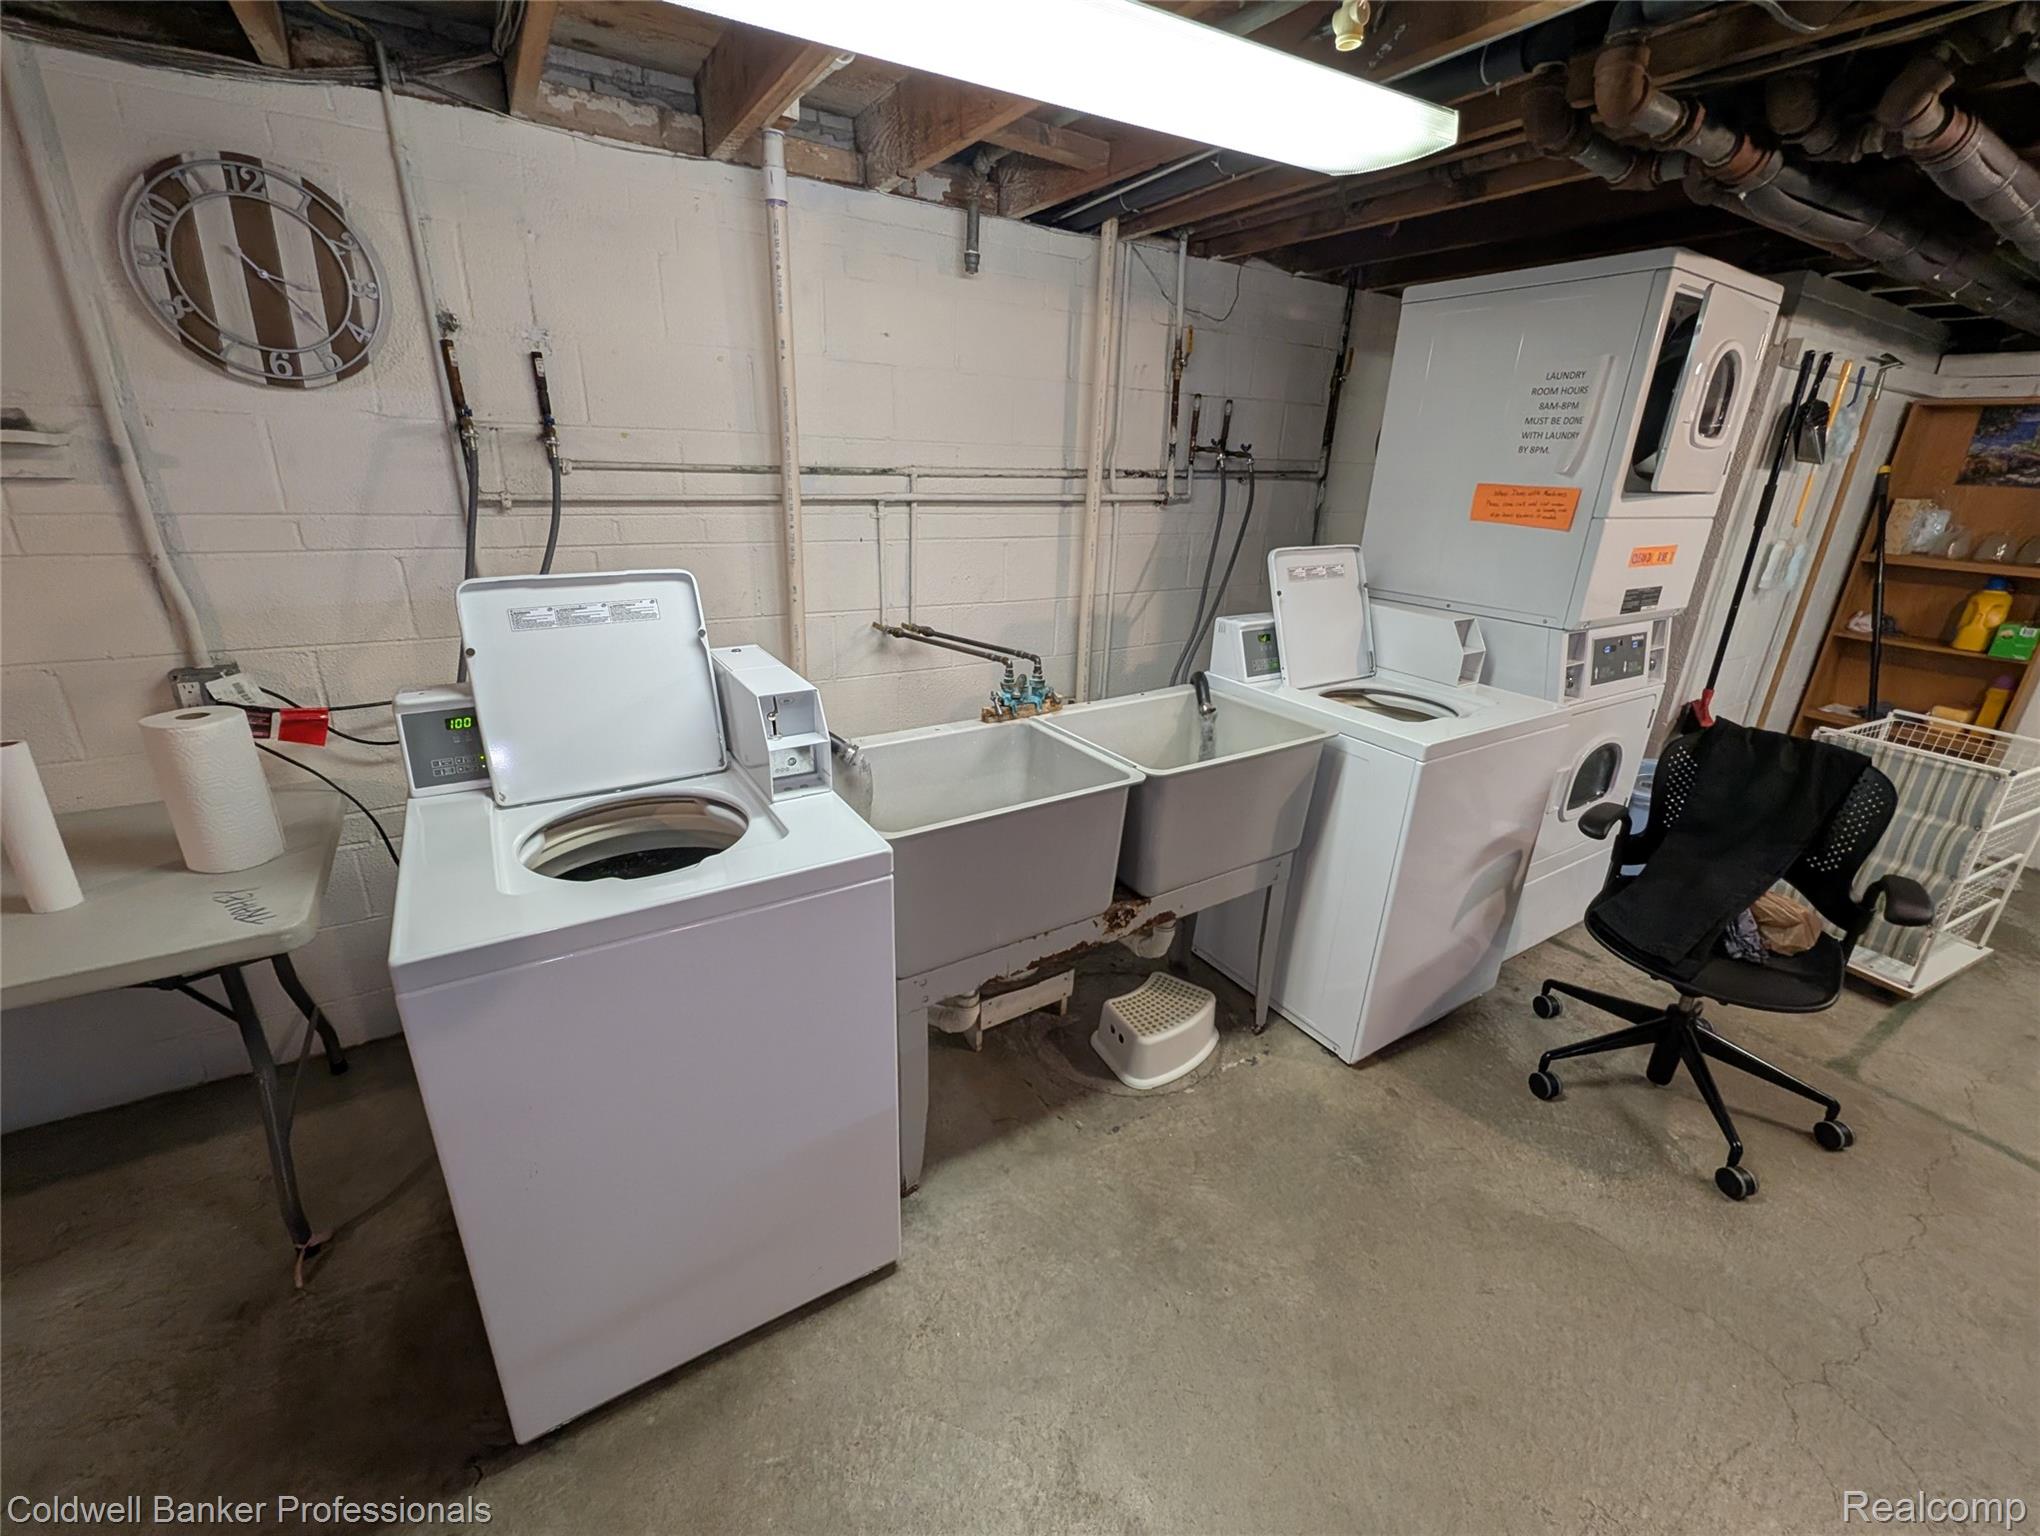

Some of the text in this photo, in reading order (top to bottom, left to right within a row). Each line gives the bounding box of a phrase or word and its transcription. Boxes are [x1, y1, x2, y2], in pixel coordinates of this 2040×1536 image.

[223, 164, 268, 200] 12
[136, 192, 178, 230] 10
[328, 231, 358, 256] 2
[350, 280, 379, 300] 3
[159, 295, 195, 320] 8
[346, 320, 373, 344] 4
[268, 351, 294, 377] 6
[1546, 371, 1586, 380] LAUNDRY
[1531, 385, 1589, 395] ROOM HOURS
[1539, 401, 1580, 410] 8AM-8PM
[1525, 416, 1584, 425] MUST BE DONE
[1521, 431, 1580, 440] WITH LAUNDRY
[1518, 446, 1528, 454] BY
[450, 717, 472, 730] 100
